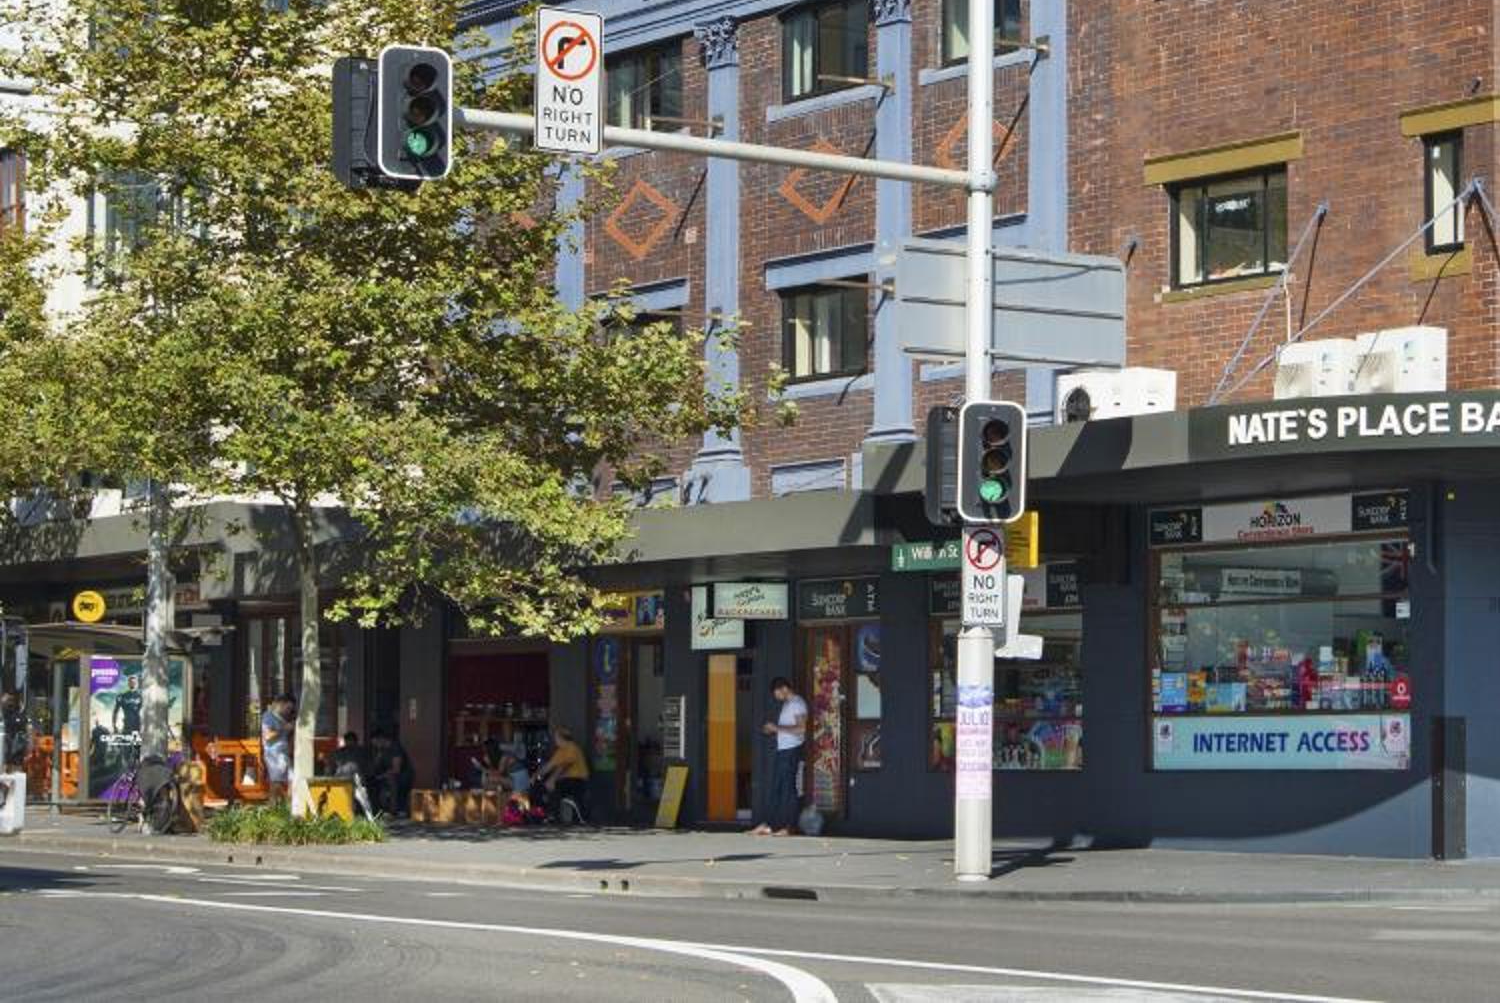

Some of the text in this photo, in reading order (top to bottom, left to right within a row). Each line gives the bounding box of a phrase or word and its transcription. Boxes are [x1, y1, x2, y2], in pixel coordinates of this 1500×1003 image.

[553, 85, 583, 105] NO
[543, 107, 593, 125] RIGHT
[545, 126, 591, 143] TURN
[1337, 402, 1450, 438] PLACE
[1250, 512, 1301, 528] HORIZON
[973, 575, 995, 591] NO
[968, 594, 1000, 606] RIGHT
[970, 606, 999, 619] TURN
[1193, 731, 1370, 753] INTERNET ACCESS
